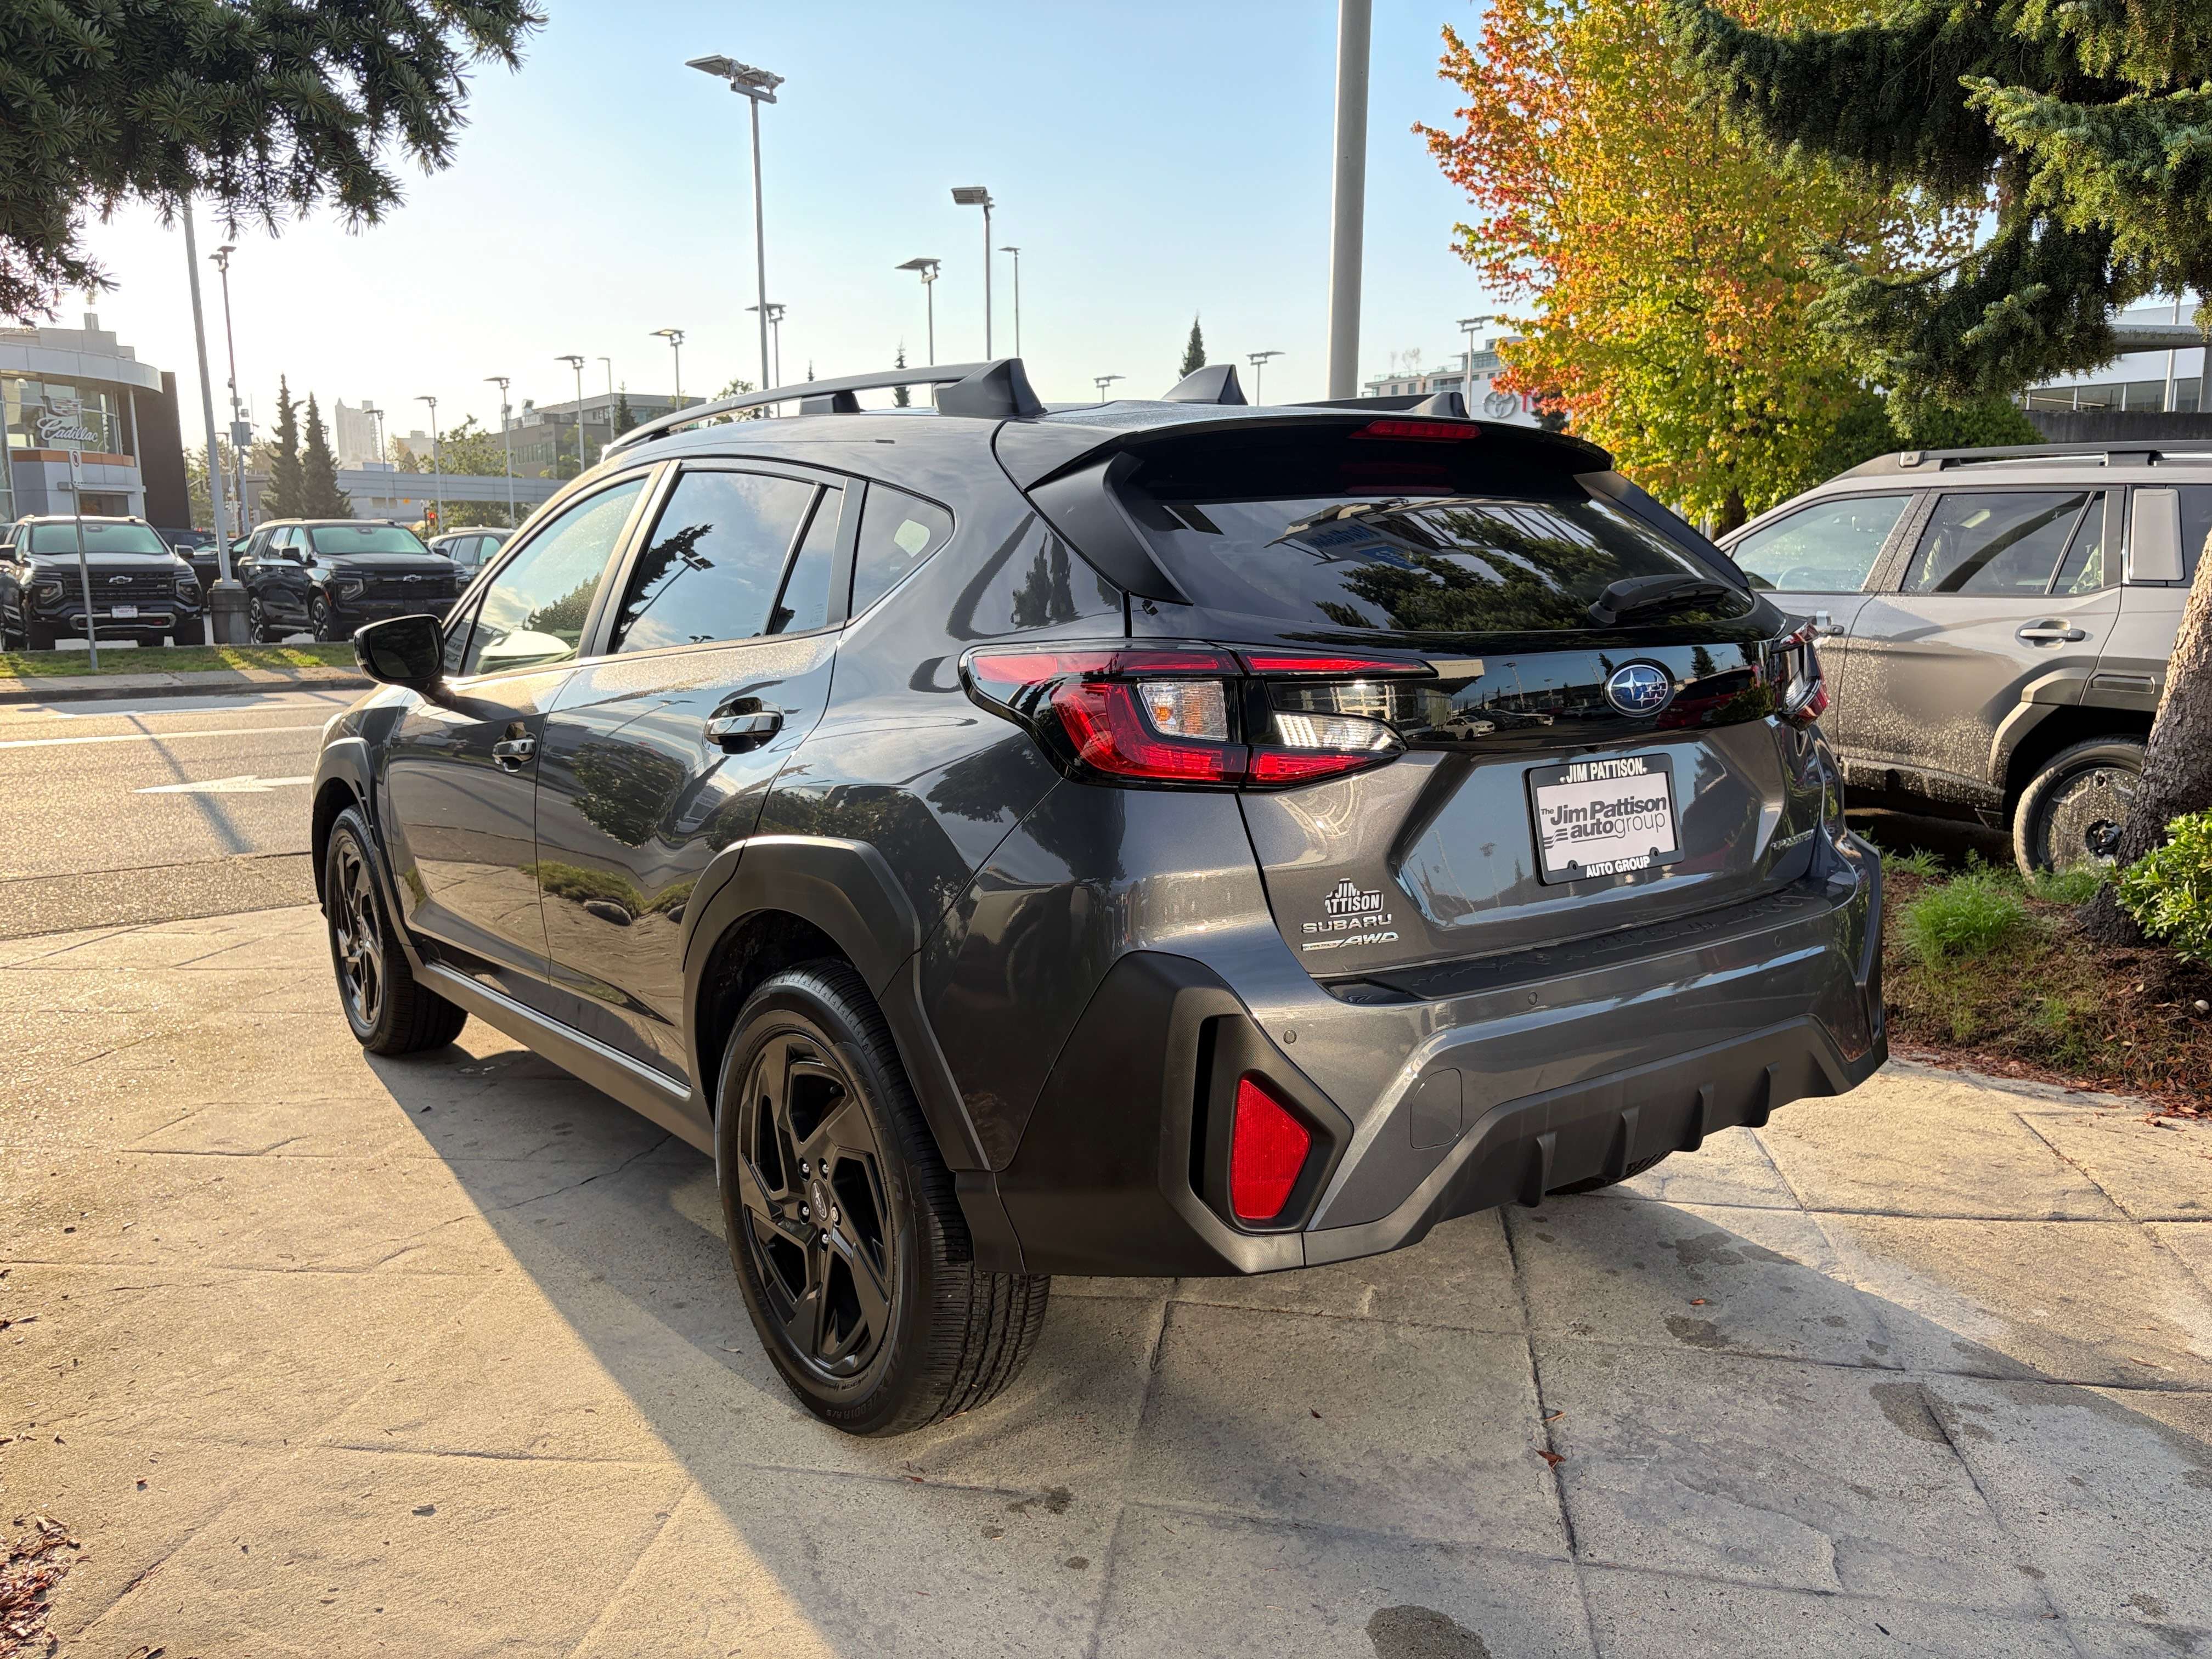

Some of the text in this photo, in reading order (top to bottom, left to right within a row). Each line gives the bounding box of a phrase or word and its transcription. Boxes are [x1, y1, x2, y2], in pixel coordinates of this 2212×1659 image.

[37, 417, 98, 442] Cadillac
[1566, 758, 1643, 783] JIM PATTISON
[1550, 804, 1587, 825] Jim
[1590, 796, 1667, 820] Pattison
[1570, 812, 1666, 838] autogroup
[1586, 856, 1650, 878] AUTO GROUP
[1335, 883, 1360, 898] JIM
[1325, 894, 1379, 913] ATTISON
[1301, 914, 1392, 934] SUBARU
[1339, 932, 1399, 948] AWD
